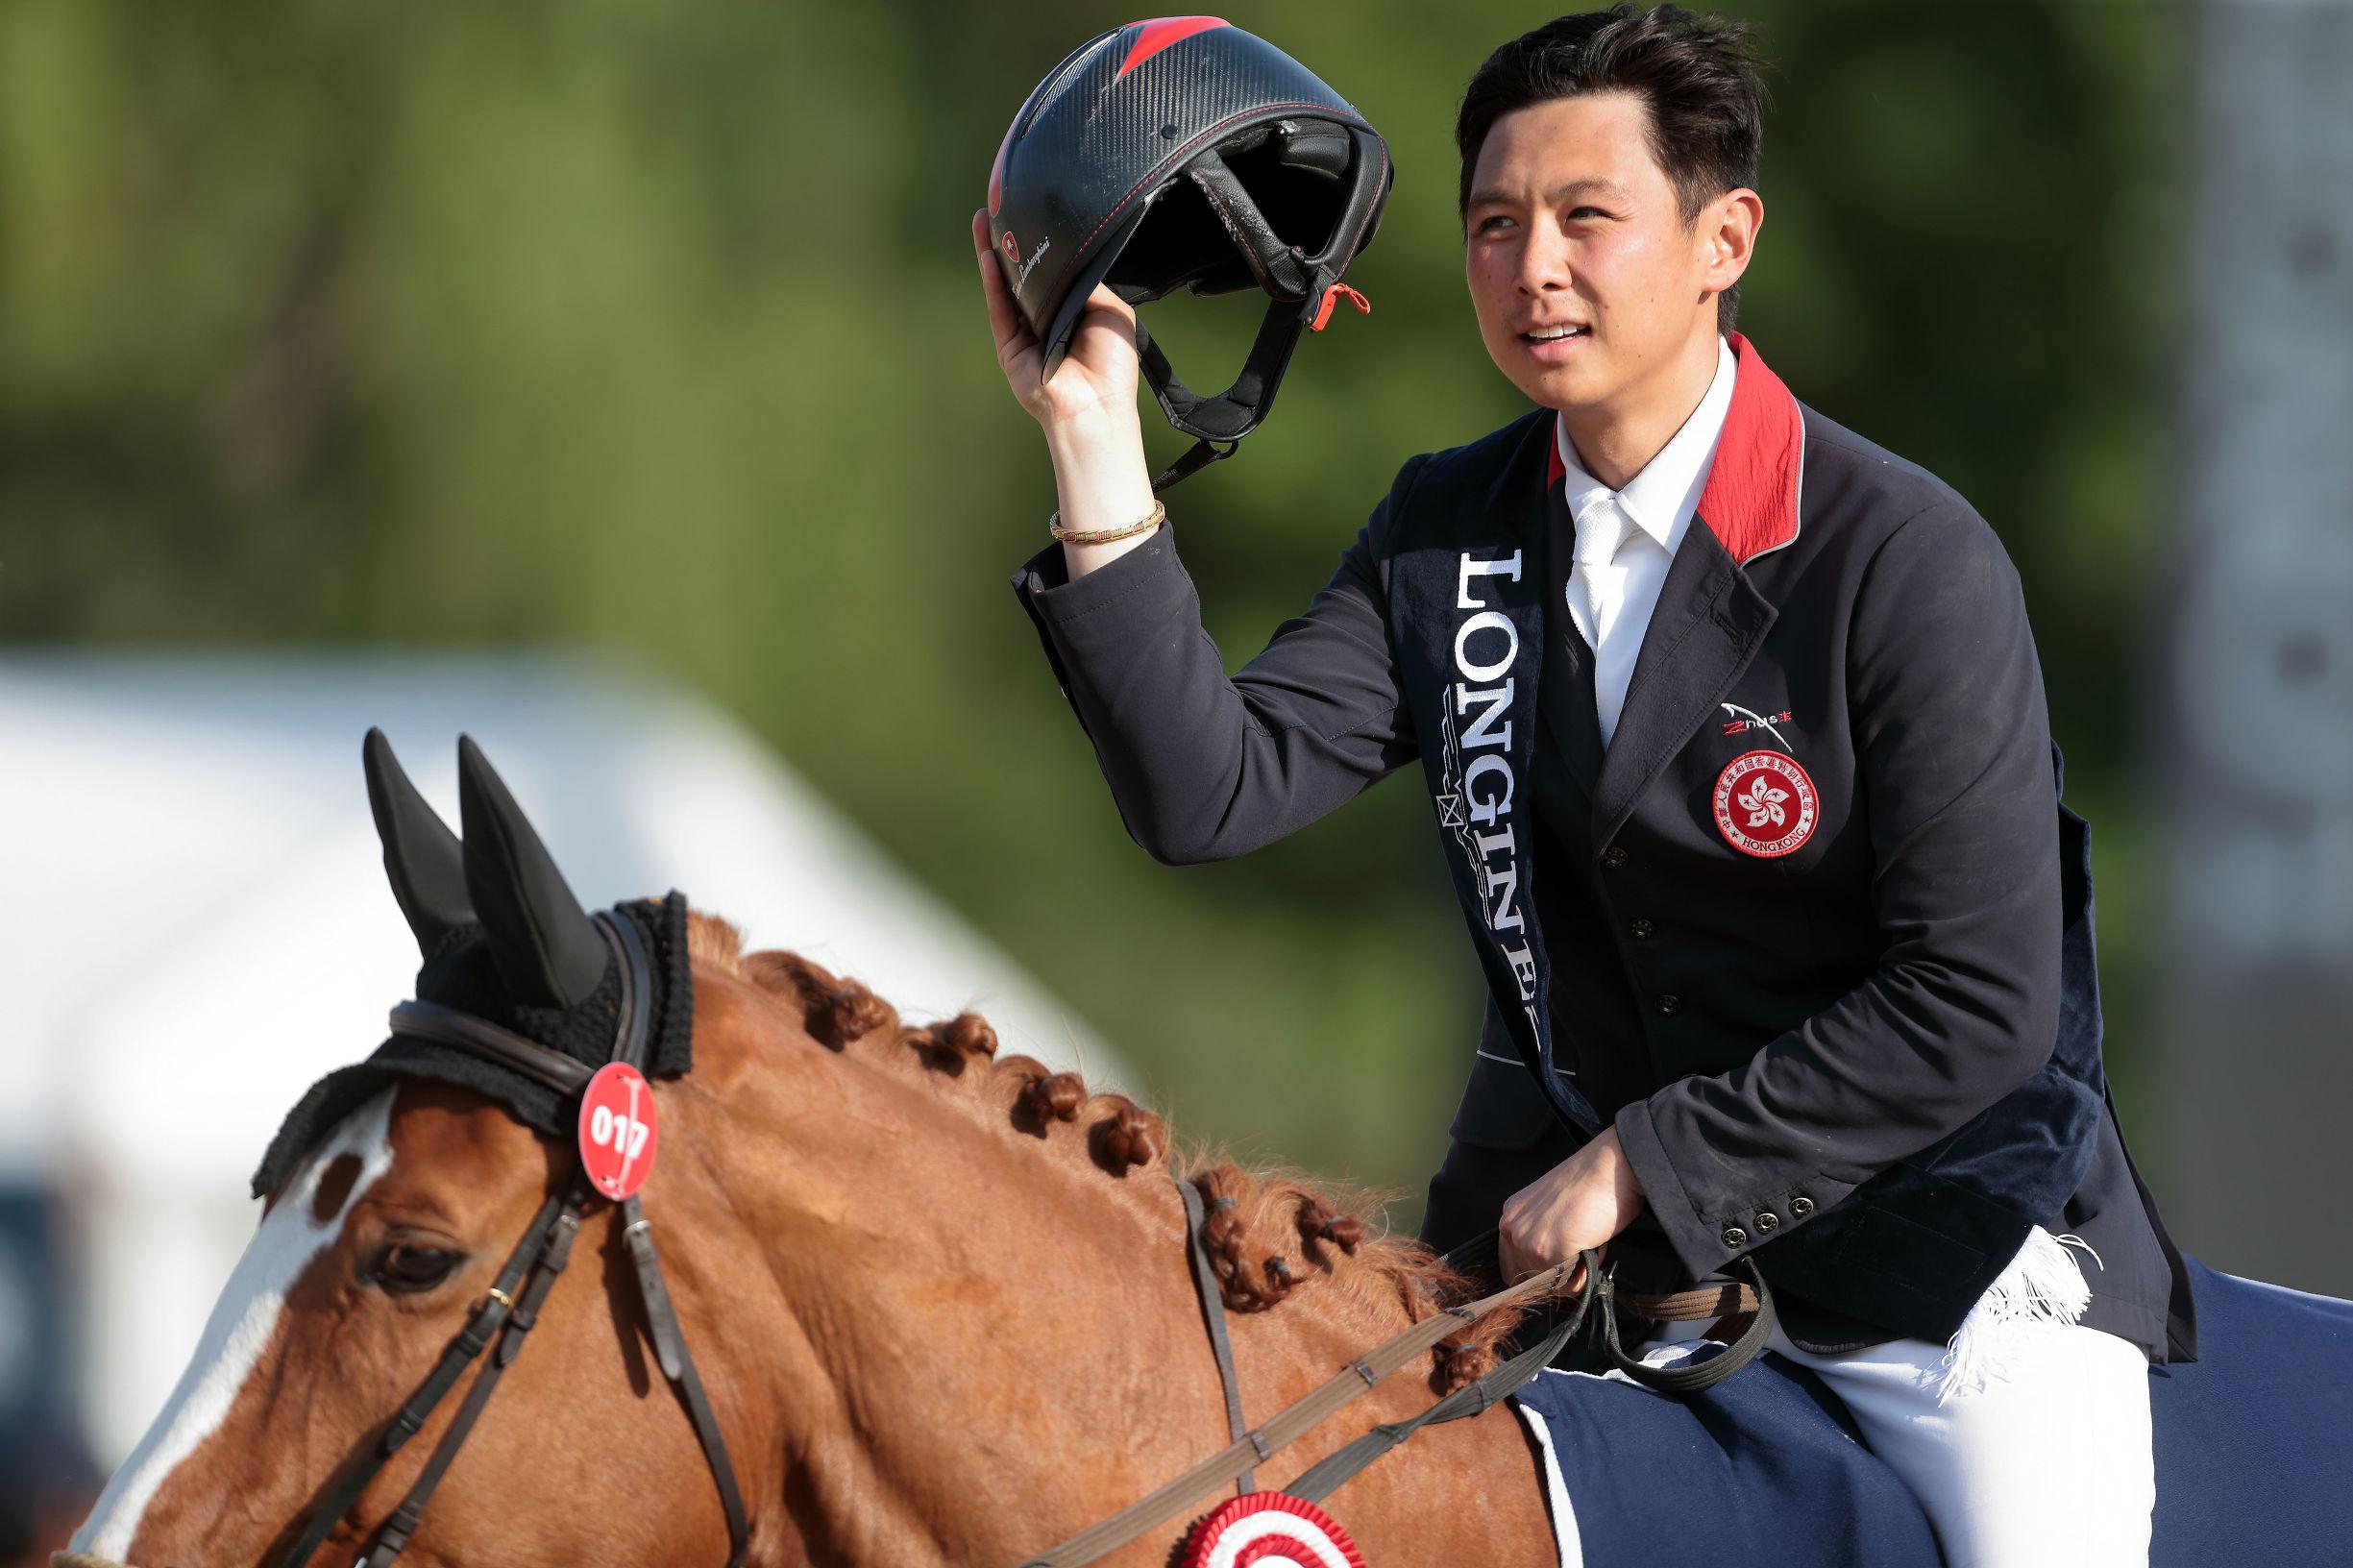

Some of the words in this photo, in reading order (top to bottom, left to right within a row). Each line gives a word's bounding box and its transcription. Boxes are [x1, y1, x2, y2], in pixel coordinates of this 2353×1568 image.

[1455, 549, 1541, 1052] LONGINE
[1742, 826, 1806, 852] HONGKONG
[590, 1104, 650, 1161] 017
